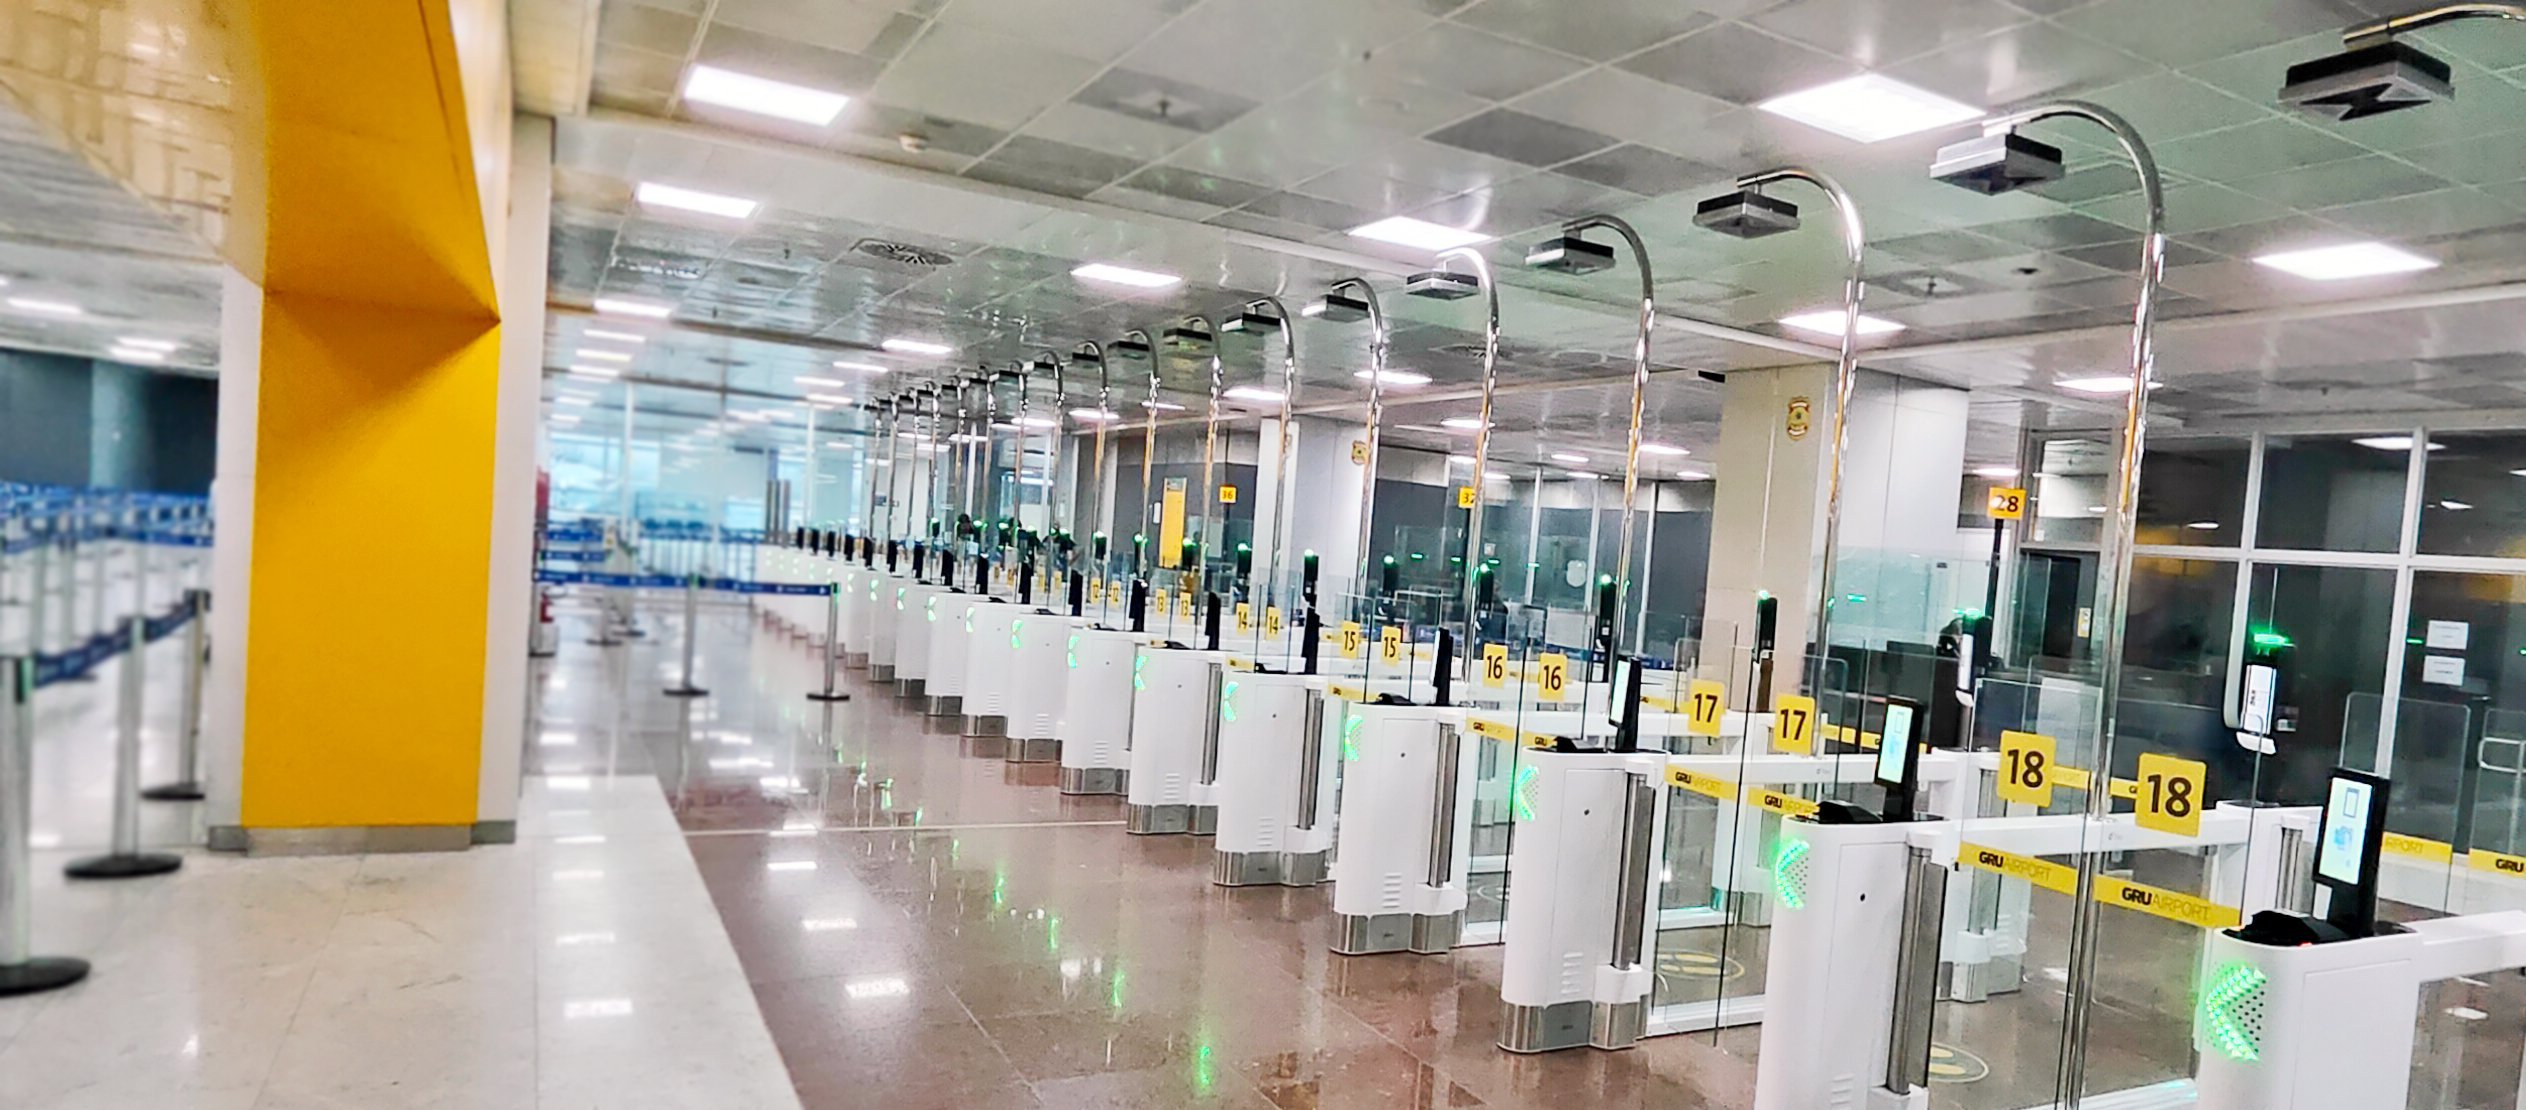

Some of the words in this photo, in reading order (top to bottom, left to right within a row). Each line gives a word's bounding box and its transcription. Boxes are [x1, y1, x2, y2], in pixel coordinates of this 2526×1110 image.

[1993, 494, 2019, 513] 28
[1238, 611, 1248, 629] 14
[1269, 615, 1279, 635] 14
[1344, 630, 1356, 652] 15
[1384, 636, 1397, 658] 15
[1486, 655, 1503, 680] 16
[1543, 665, 1562, 691] 16
[1694, 693, 1718, 723] 17
[1780, 708, 1807, 741] 17
[2007, 749, 2044, 788] 18
[2147, 774, 2192, 818] 18
